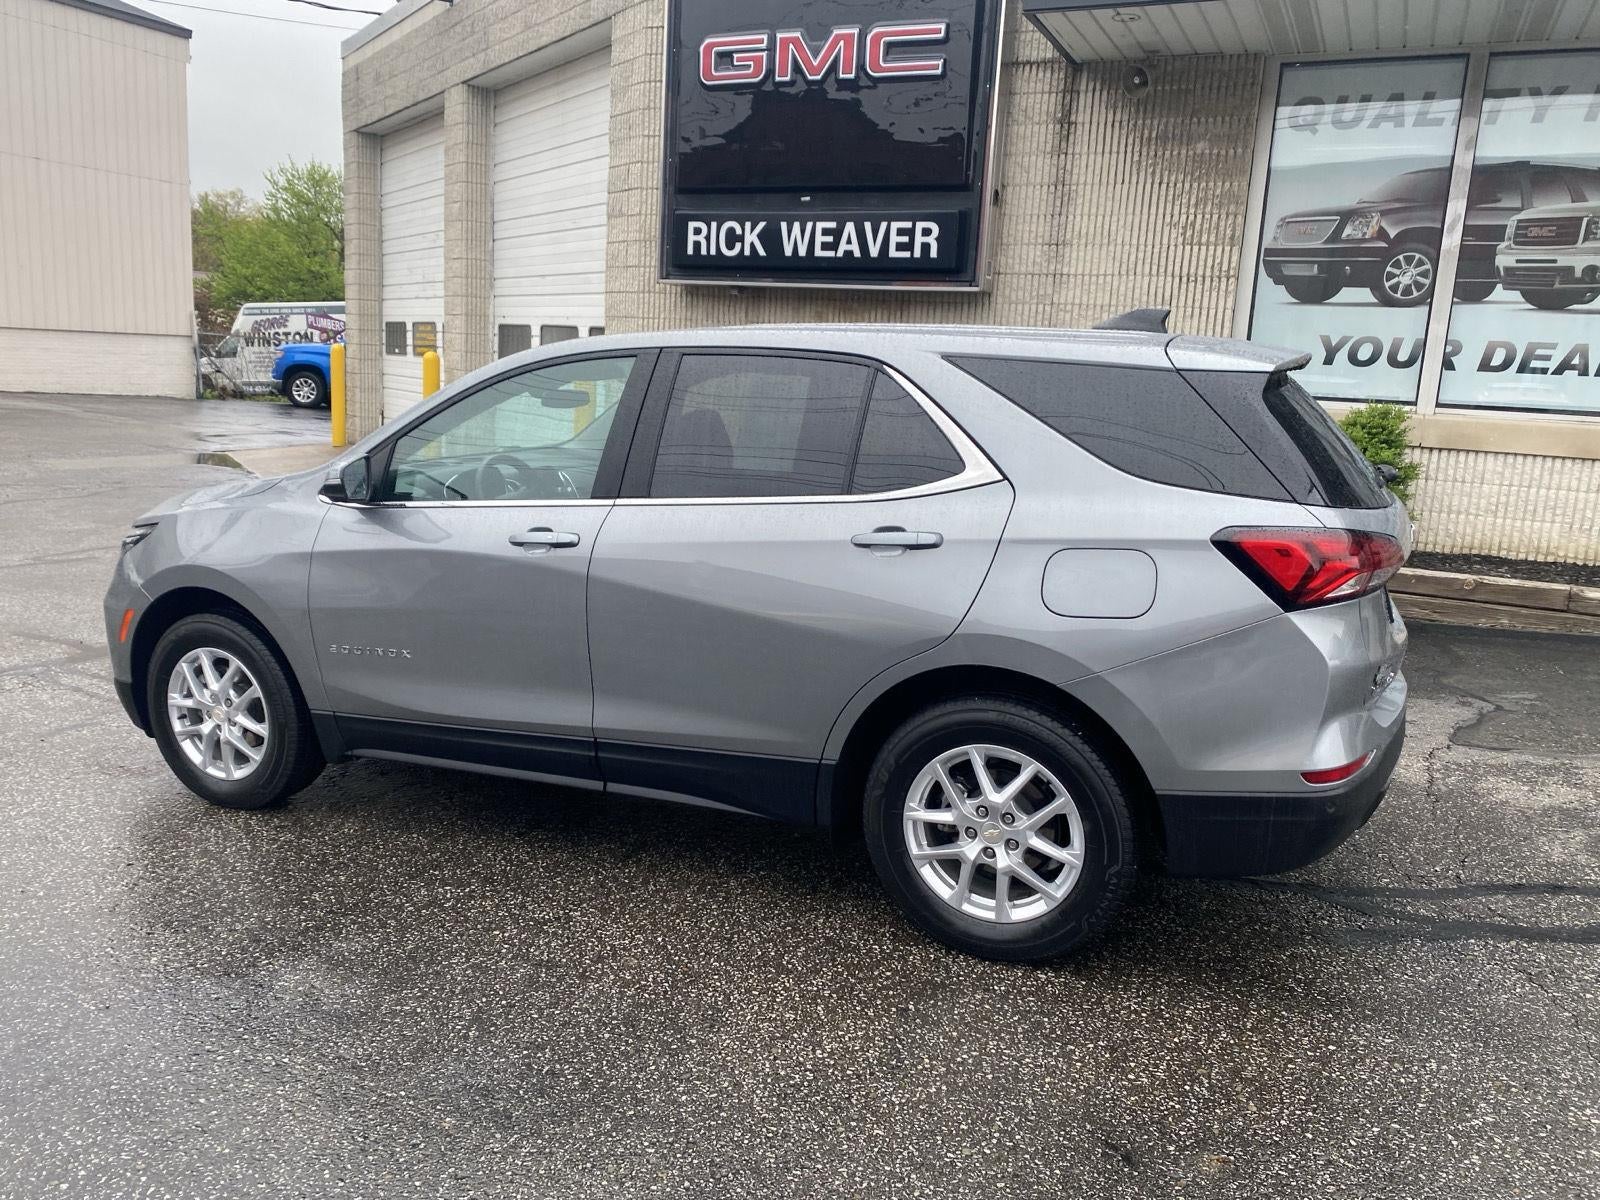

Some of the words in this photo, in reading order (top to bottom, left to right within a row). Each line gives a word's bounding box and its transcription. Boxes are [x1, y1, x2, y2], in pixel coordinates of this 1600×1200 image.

[699, 22, 947, 85] GMC
[1287, 85, 1570, 135] QUALTY
[686, 220, 767, 257] RICK
[780, 221, 940, 258] WEAVER
[251, 314, 290, 334] GEORGE
[307, 314, 345, 332] PLUMBERS
[242, 331, 314, 347] WINSTON
[1476, 340, 1600, 378] DEA
[329, 644, 412, 658] EQUINOX
